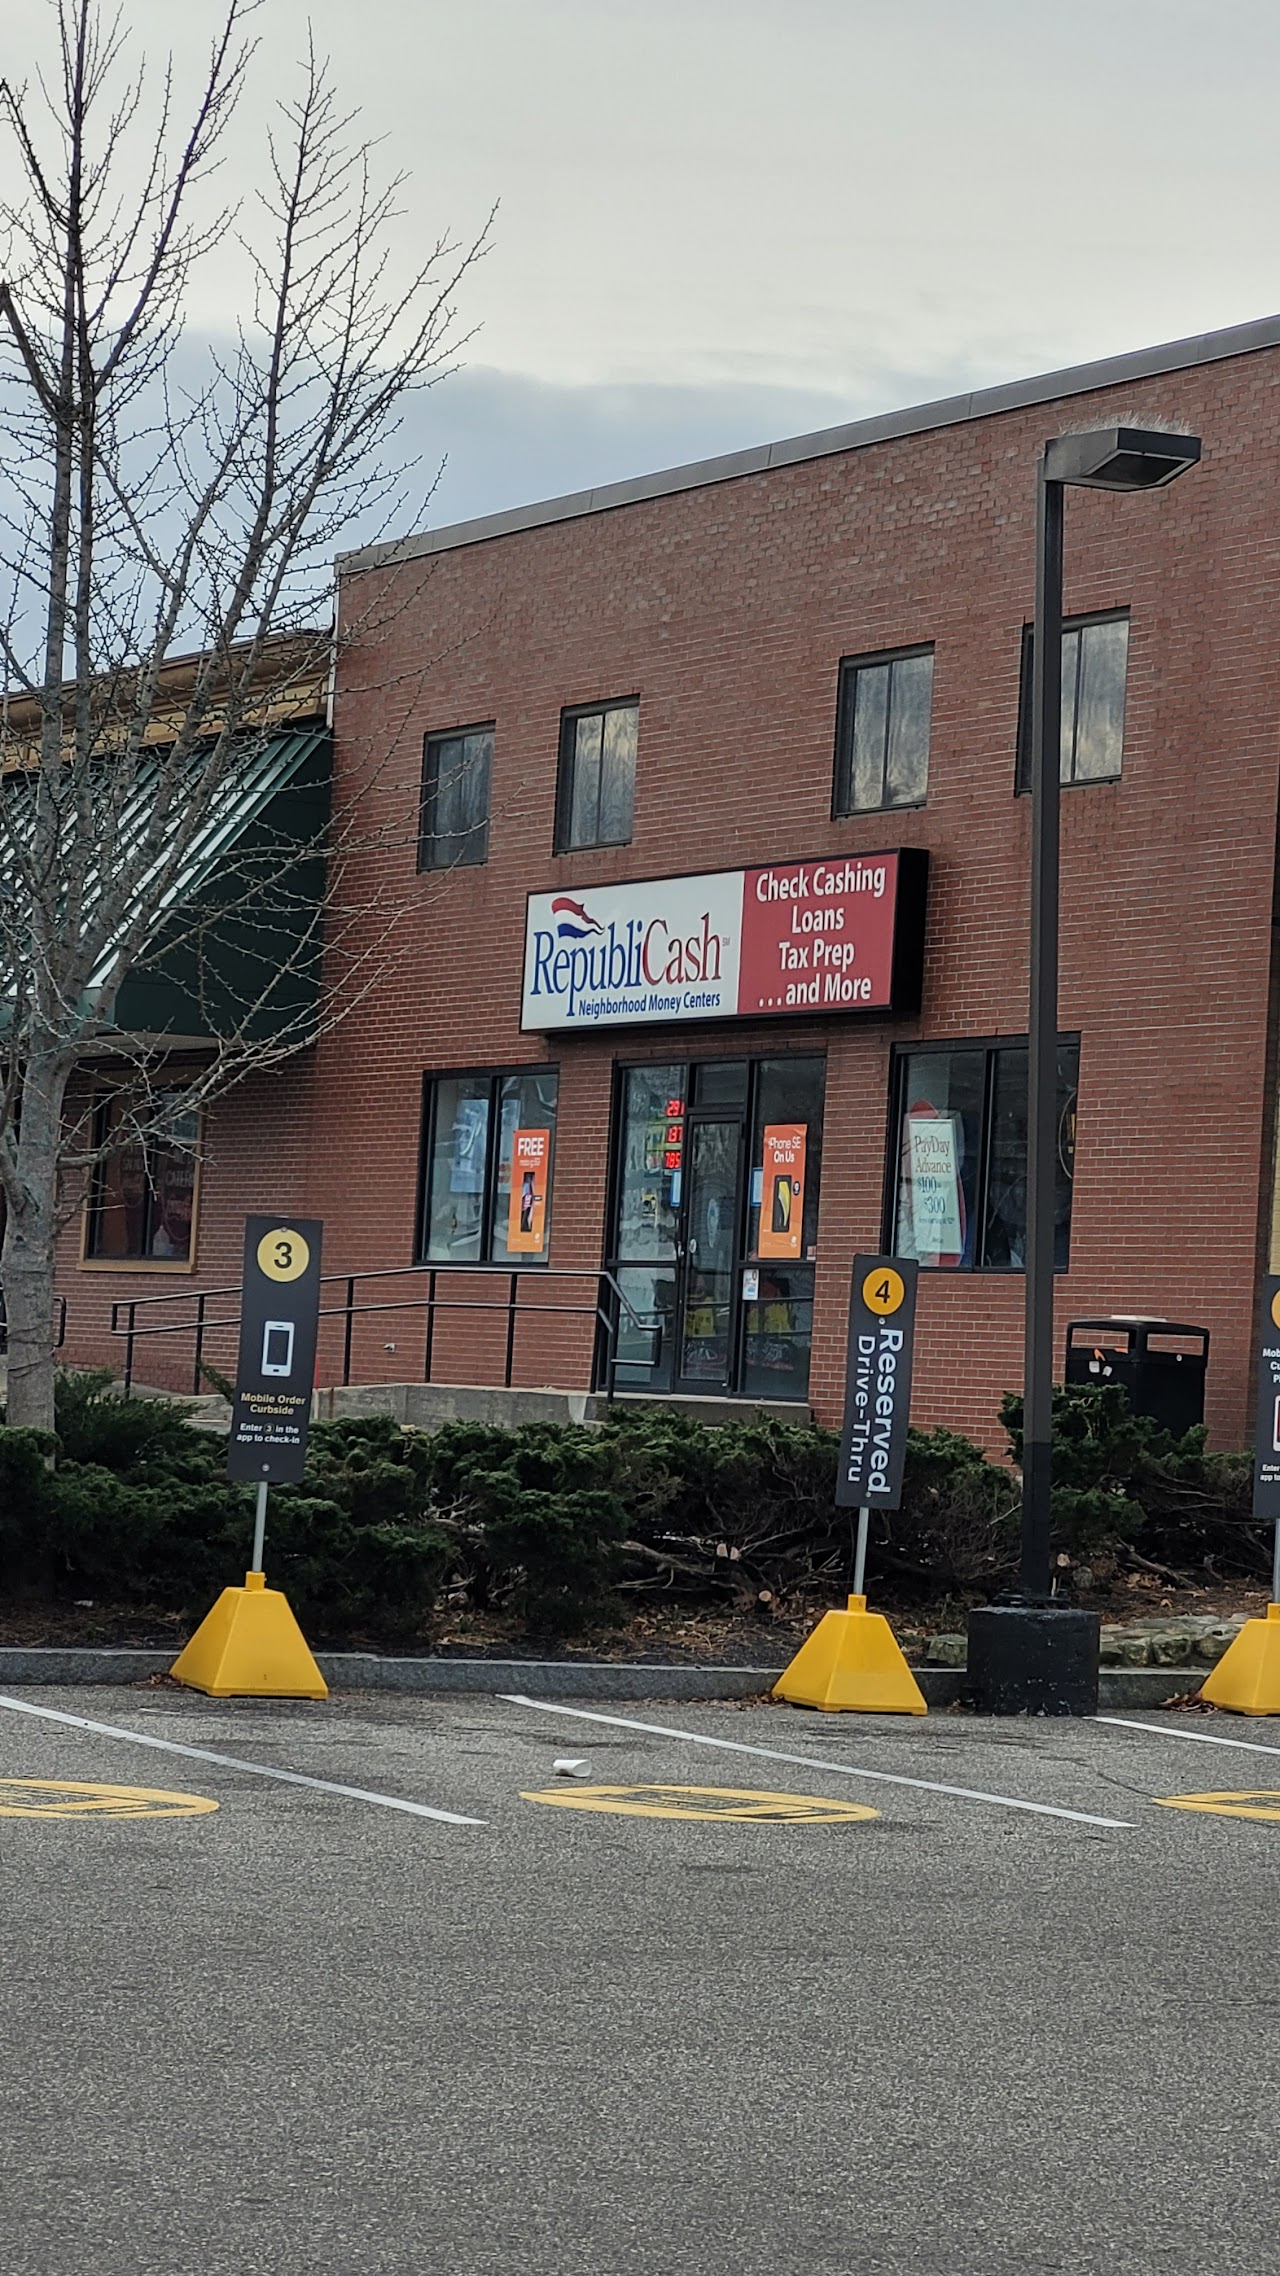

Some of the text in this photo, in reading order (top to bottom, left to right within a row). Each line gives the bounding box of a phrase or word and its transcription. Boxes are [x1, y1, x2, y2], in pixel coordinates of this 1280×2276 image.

[756, 862, 886, 902] Check Cashing
[792, 905, 844, 934] Loans
[530, 912, 721, 1017] RepubliCash
[779, 938, 855, 973] Tax Prep
[824, 972, 872, 1002] More
[579, 991, 721, 1019] Neighborhood Money Centers
[517, 1137, 545, 1157] FREE
[792, 1136, 801, 1149] SE
[914, 1135, 950, 1157] PayDay
[774, 1150, 795, 1163] On Us
[915, 1157, 951, 1173] Advance
[917, 1176, 936, 1193] $100
[924, 1196, 946, 1214] $300
[274, 1241, 292, 1269] 3
[874, 1280, 891, 1304] 4
[241, 1392, 306, 1405] Mobile Order
[250, 1404, 294, 1415] Curbside
[847, 1335, 876, 1483] Drive-Thru
[867, 1328, 904, 1493] Reserved
[236, 1434, 300, 1444] app to check-in
[240, 1423, 263, 1432] Enter
[275, 1425, 284, 1433] in
[285, 1425, 299, 1434] the
